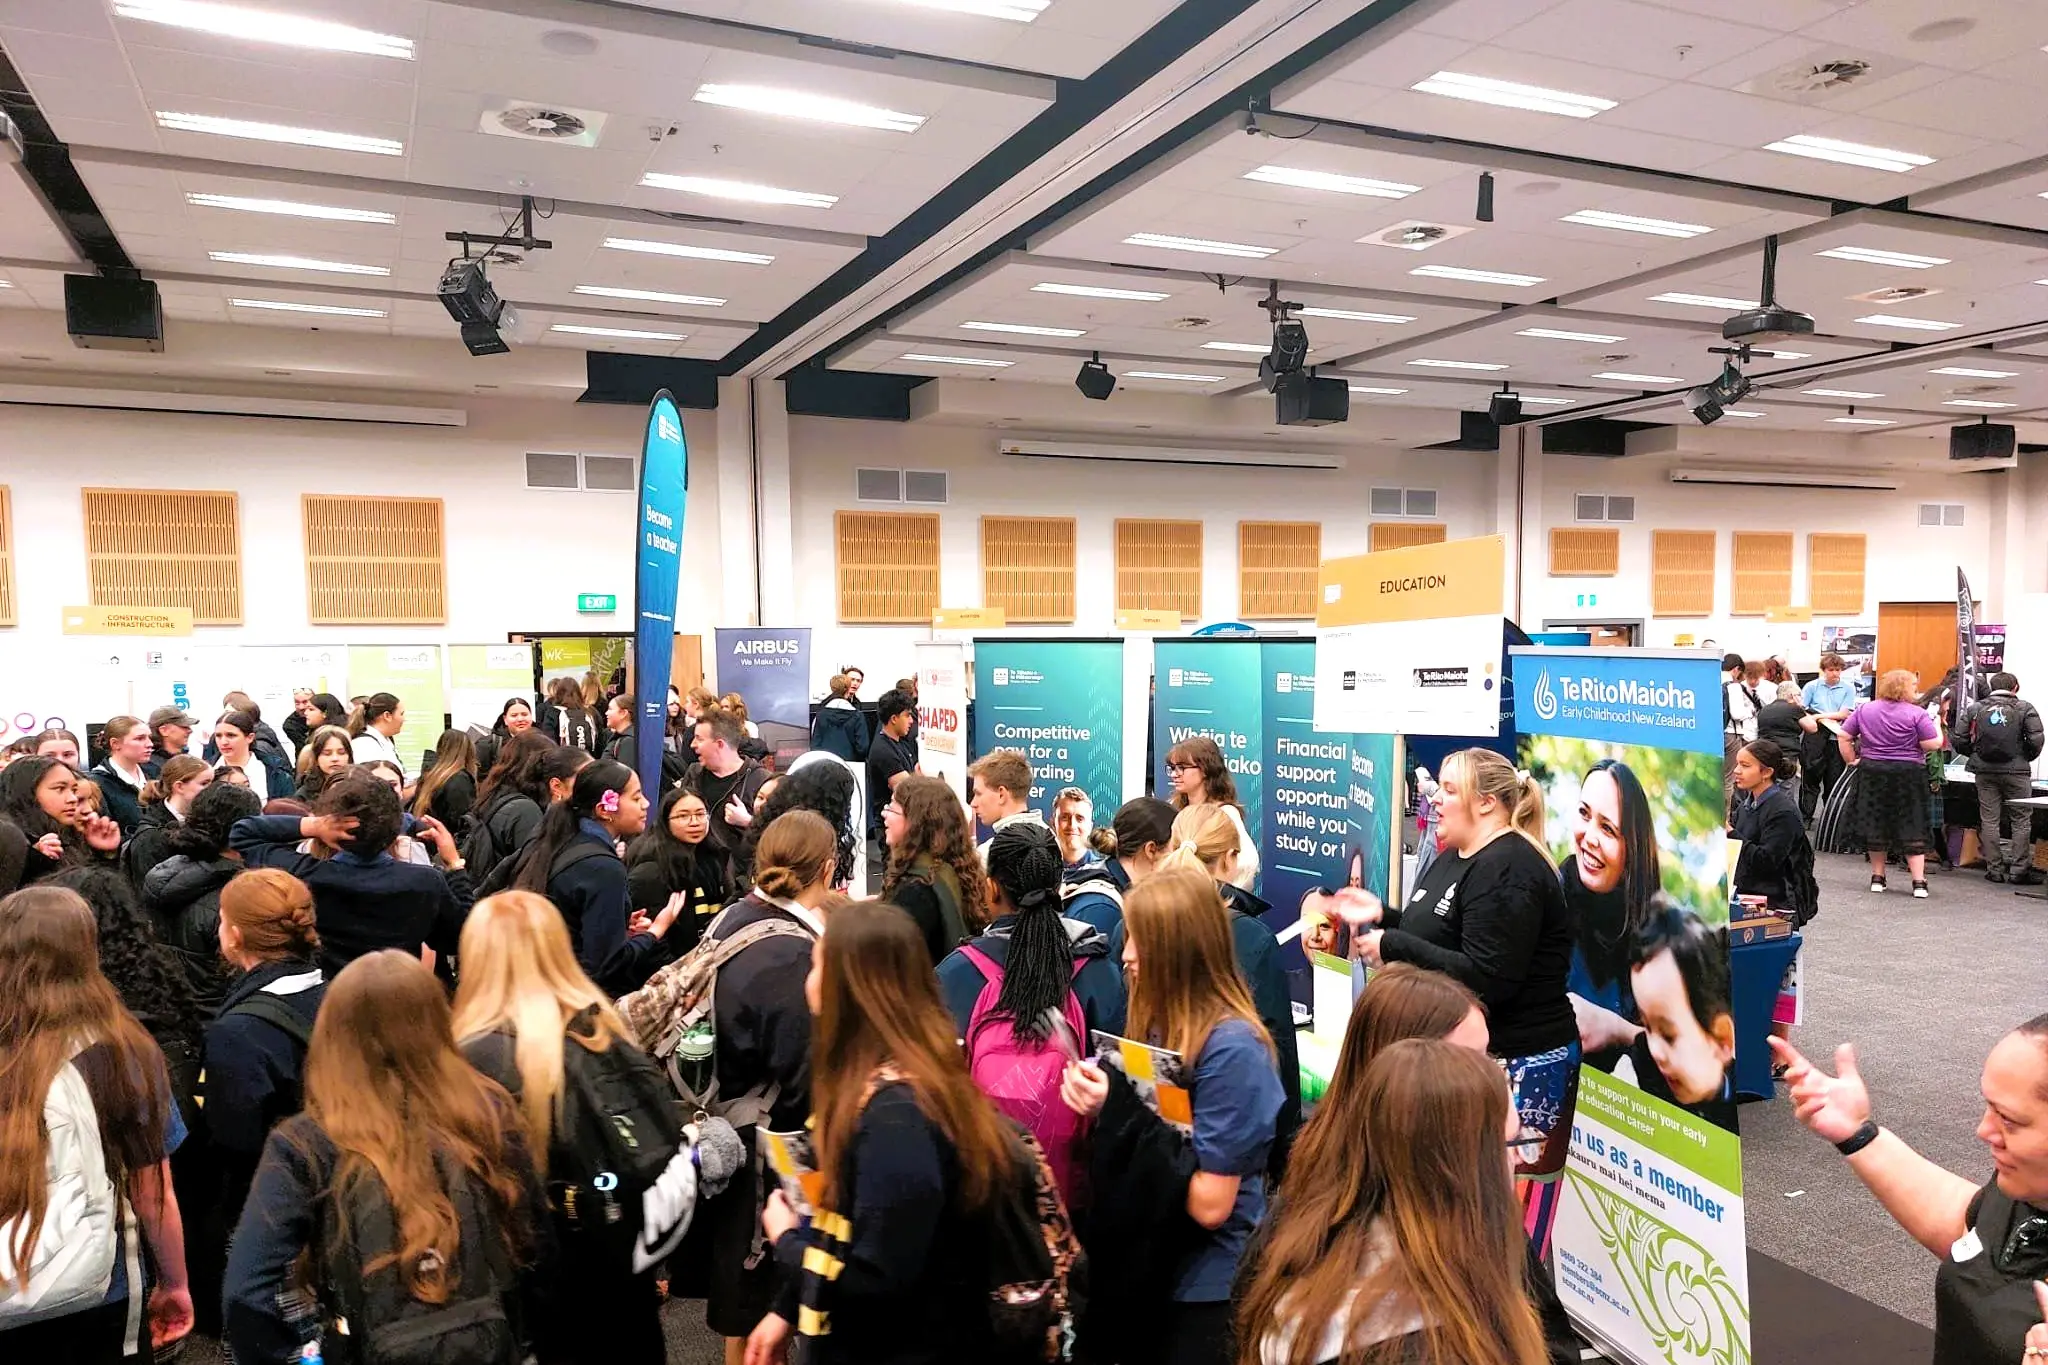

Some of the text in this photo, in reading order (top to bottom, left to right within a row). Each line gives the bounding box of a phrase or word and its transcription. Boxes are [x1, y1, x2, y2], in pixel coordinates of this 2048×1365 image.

[646, 503, 673, 530] Become
[646, 531, 678, 555] a teacher
[1379, 575, 1446, 594] EDUCATION
[585, 596, 608, 609] EXIT
[107, 614, 169, 622] CONSTRUCTION
[733, 639, 799, 655] AIRBUS
[741, 658, 753, 666] We
[754, 658, 774, 666] Make
[782, 657, 793, 667] Fly
[1559, 677, 1696, 710] Te Rito Maioha
[918, 706, 958, 733] SHAPED
[1562, 705, 1696, 730] Early Childhood New Zealand
[994, 723, 1091, 742] Competitive
[1229, 730, 1247, 749] te
[1029, 744, 1052, 759] for
[1057, 747, 1068, 760] a
[1277, 738, 1346, 760] Financial
[1276, 765, 1336, 784] support
[1351, 748, 1374, 780] Become
[1276, 788, 1347, 810] opportun
[1354, 782, 1375, 813] teacher
[1275, 810, 1347, 835] while you
[1275, 833, 1318, 857] study
[1321, 843, 1338, 858] or
[1586, 1094, 1625, 1122] education
[1627, 1115, 1655, 1136] career
[1587, 1077, 1596, 1090] to
[1598, 1083, 1629, 1107] support
[1631, 1101, 1647, 1116] you
[1649, 1107, 1658, 1120] in
[1660, 1111, 1681, 1132] your
[1682, 1124, 1708, 1147] early
[1586, 1132, 1605, 1157] us
[1610, 1145, 1628, 1170] as
[1633, 1157, 1643, 1178] a
[1648, 1165, 1725, 1224] member
[1599, 1165, 1617, 1182] mai
[1618, 1172, 1634, 1191] hei
[1635, 1188, 1666, 1210] mema
